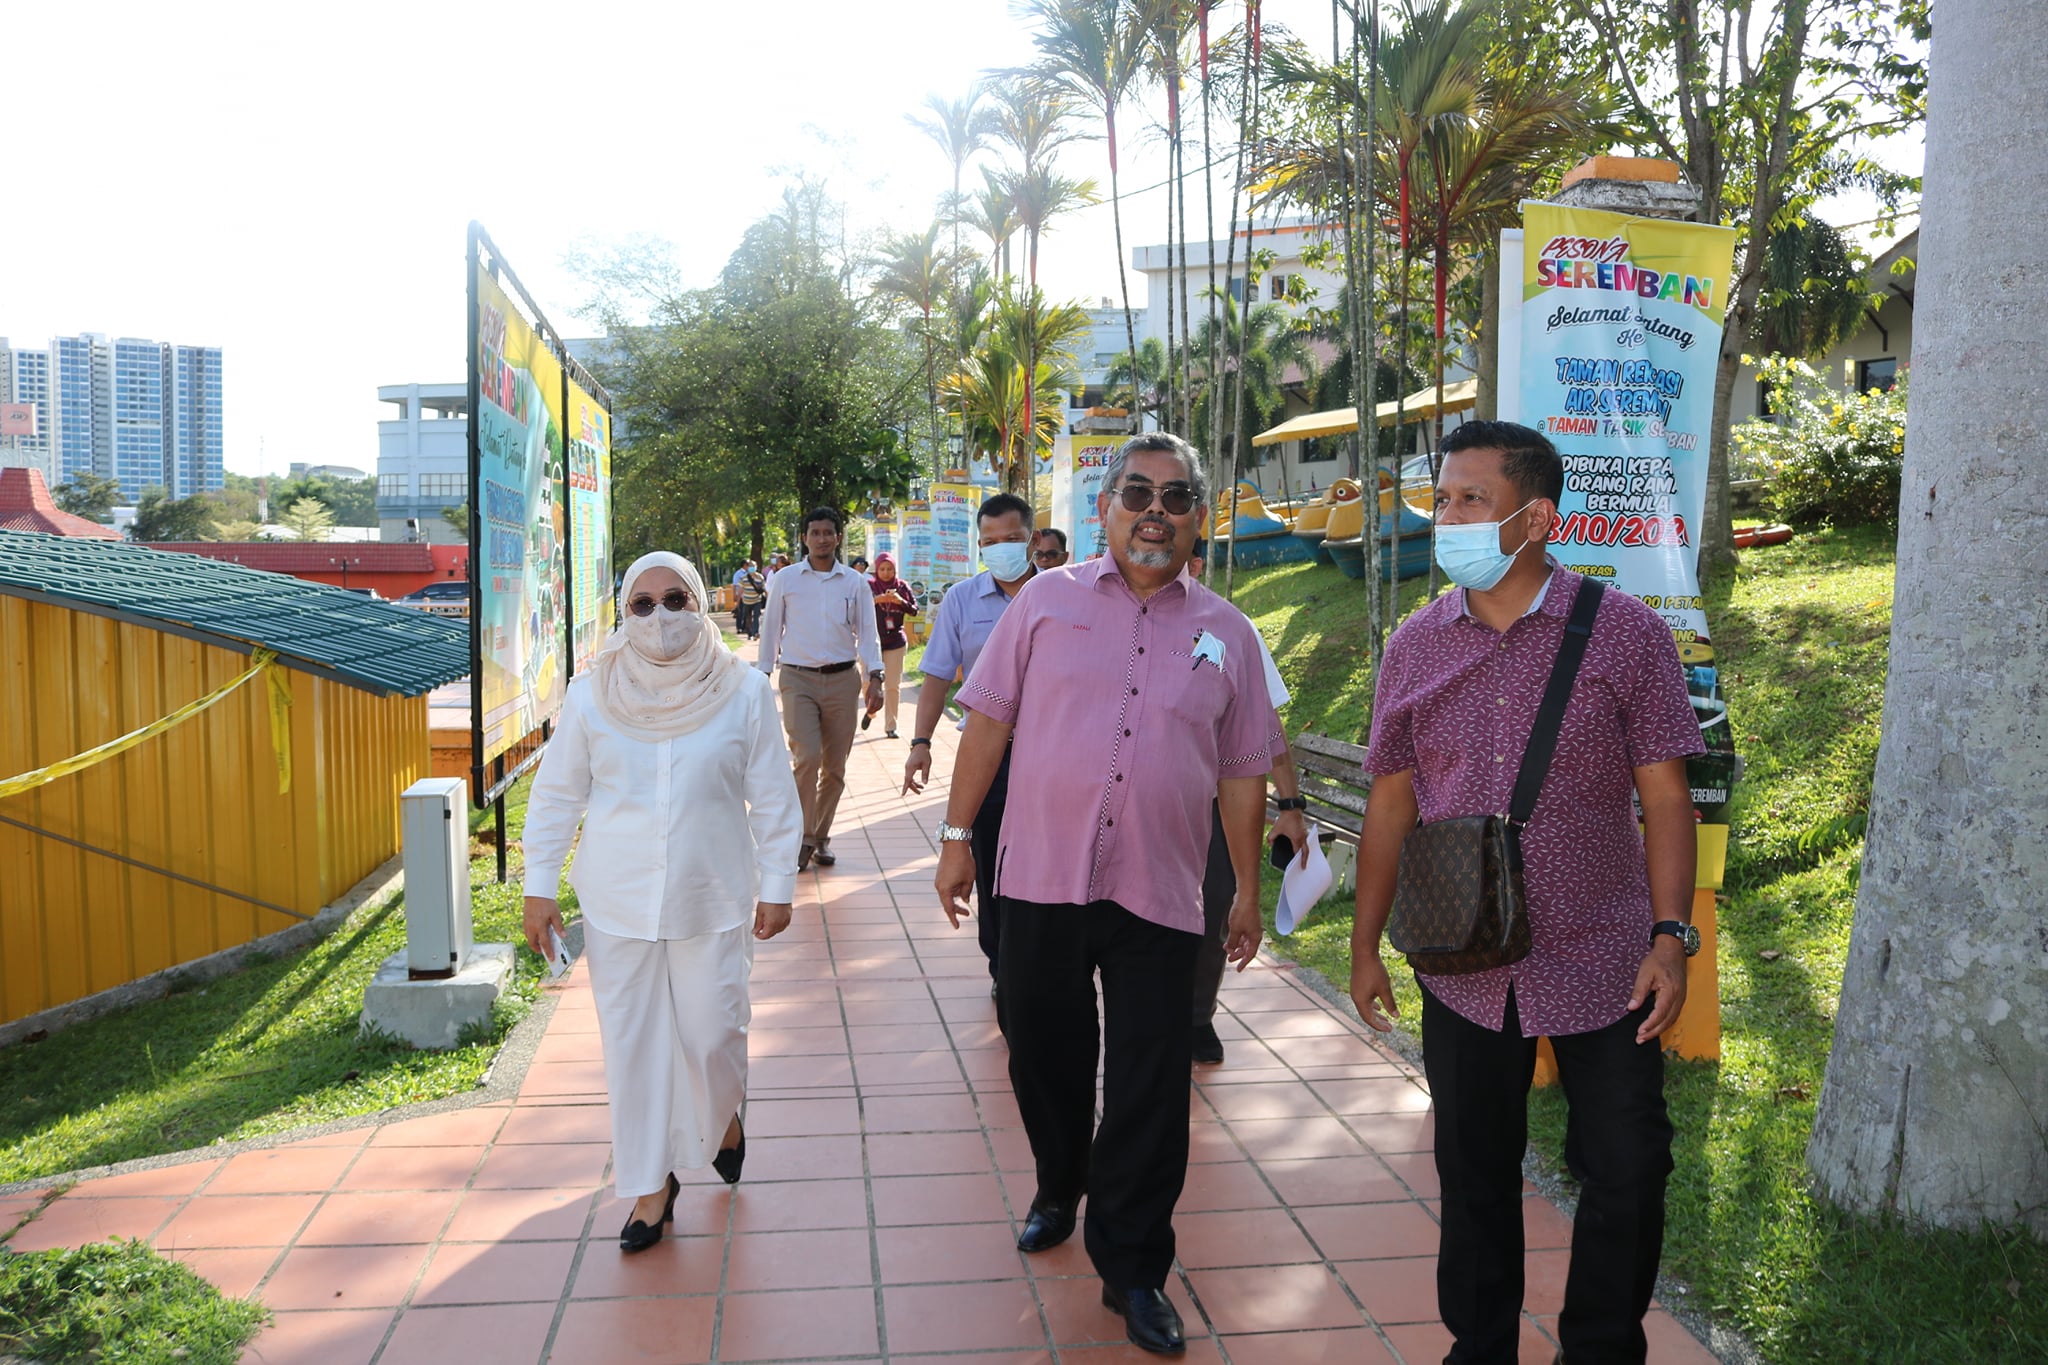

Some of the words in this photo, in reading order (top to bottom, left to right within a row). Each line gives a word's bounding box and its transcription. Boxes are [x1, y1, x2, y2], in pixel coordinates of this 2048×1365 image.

[1546, 306, 1631, 331] Selamat
[1616, 328, 1644, 349] Ke
[1555, 358, 1621, 386] TAMAN
[1564, 388, 1599, 416] AIR
[1602, 419, 1647, 437] TASIK
[1562, 455, 1623, 476] DIBUKA
[1567, 476, 1627, 494] ORANG
[1630, 475, 1677, 495] RAM
[1586, 493, 1671, 514] BERMULA
